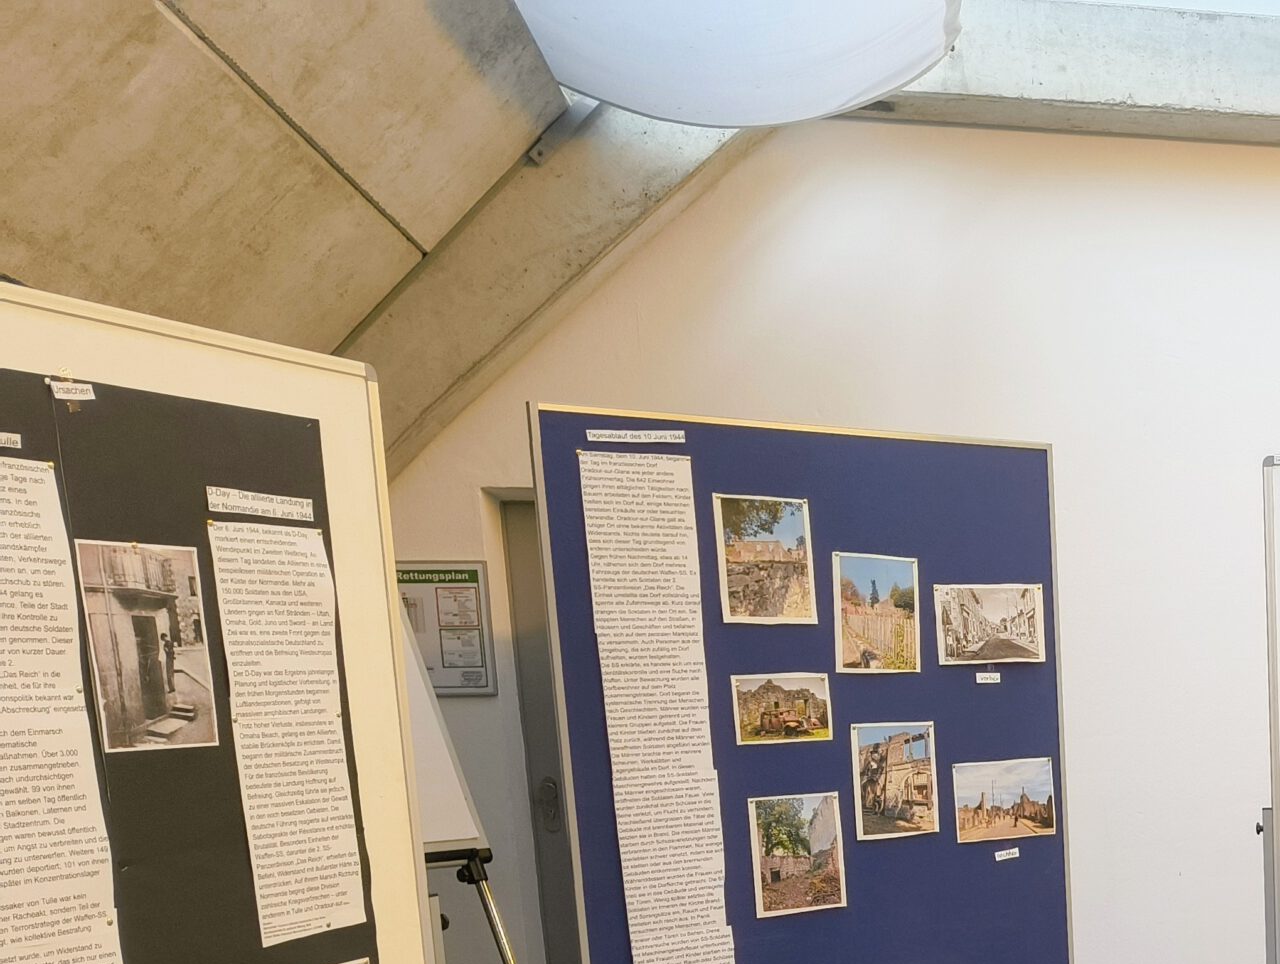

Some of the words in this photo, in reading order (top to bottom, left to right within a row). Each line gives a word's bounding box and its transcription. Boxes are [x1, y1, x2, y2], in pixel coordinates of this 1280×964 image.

[588, 432, 628, 440] Tagesablauf
[0, 436, 19, 447] ulle
[208, 487, 230, 498] D-Day
[276, 496, 304, 508] Landung
[222, 503, 260, 514] Normandie
[281, 509, 294, 517] Juni
[296, 512, 312, 520] 1944
[216, 546, 252, 554] Wendepunkt
[10, 591, 33, 599] gelang
[44, 625, 73, 633] Soldaten
[28, 728, 63, 736] Einmarsch
[41, 749, 58, 758] Über
[60, 749, 78, 757] 3.000
[10, 761, 79, 771] zusammengetrieben
[16, 772, 74, 782] undurchsichtigen
[18, 797, 41, 805] selben
[44, 796, 56, 804] Tag
[57, 793, 87, 802] öffentlich
[43, 806, 72, 815] Laternen
[53, 817, 65, 825] Die
[15, 832, 36, 840] waren
[38, 829, 66, 837] bewusst
[67, 826, 97, 835] öffentlich
[17, 843, 40, 852] Angst
[49, 839, 83, 848] verbreiten
[0, 880, 21, 889] später
[34, 870, 100, 883] Konzentrationslager
[49, 907, 76, 915] sondern
[11, 920, 60, 932] Terrorstrategie
[24, 932, 56, 941] kollektive
[57, 925, 92, 937] Bestrafung
[56, 943, 93, 956] Widerstand
[72, 955, 86, 963] sich
[86, 954, 97, 962] nur
[98, 951, 117, 960] einen
